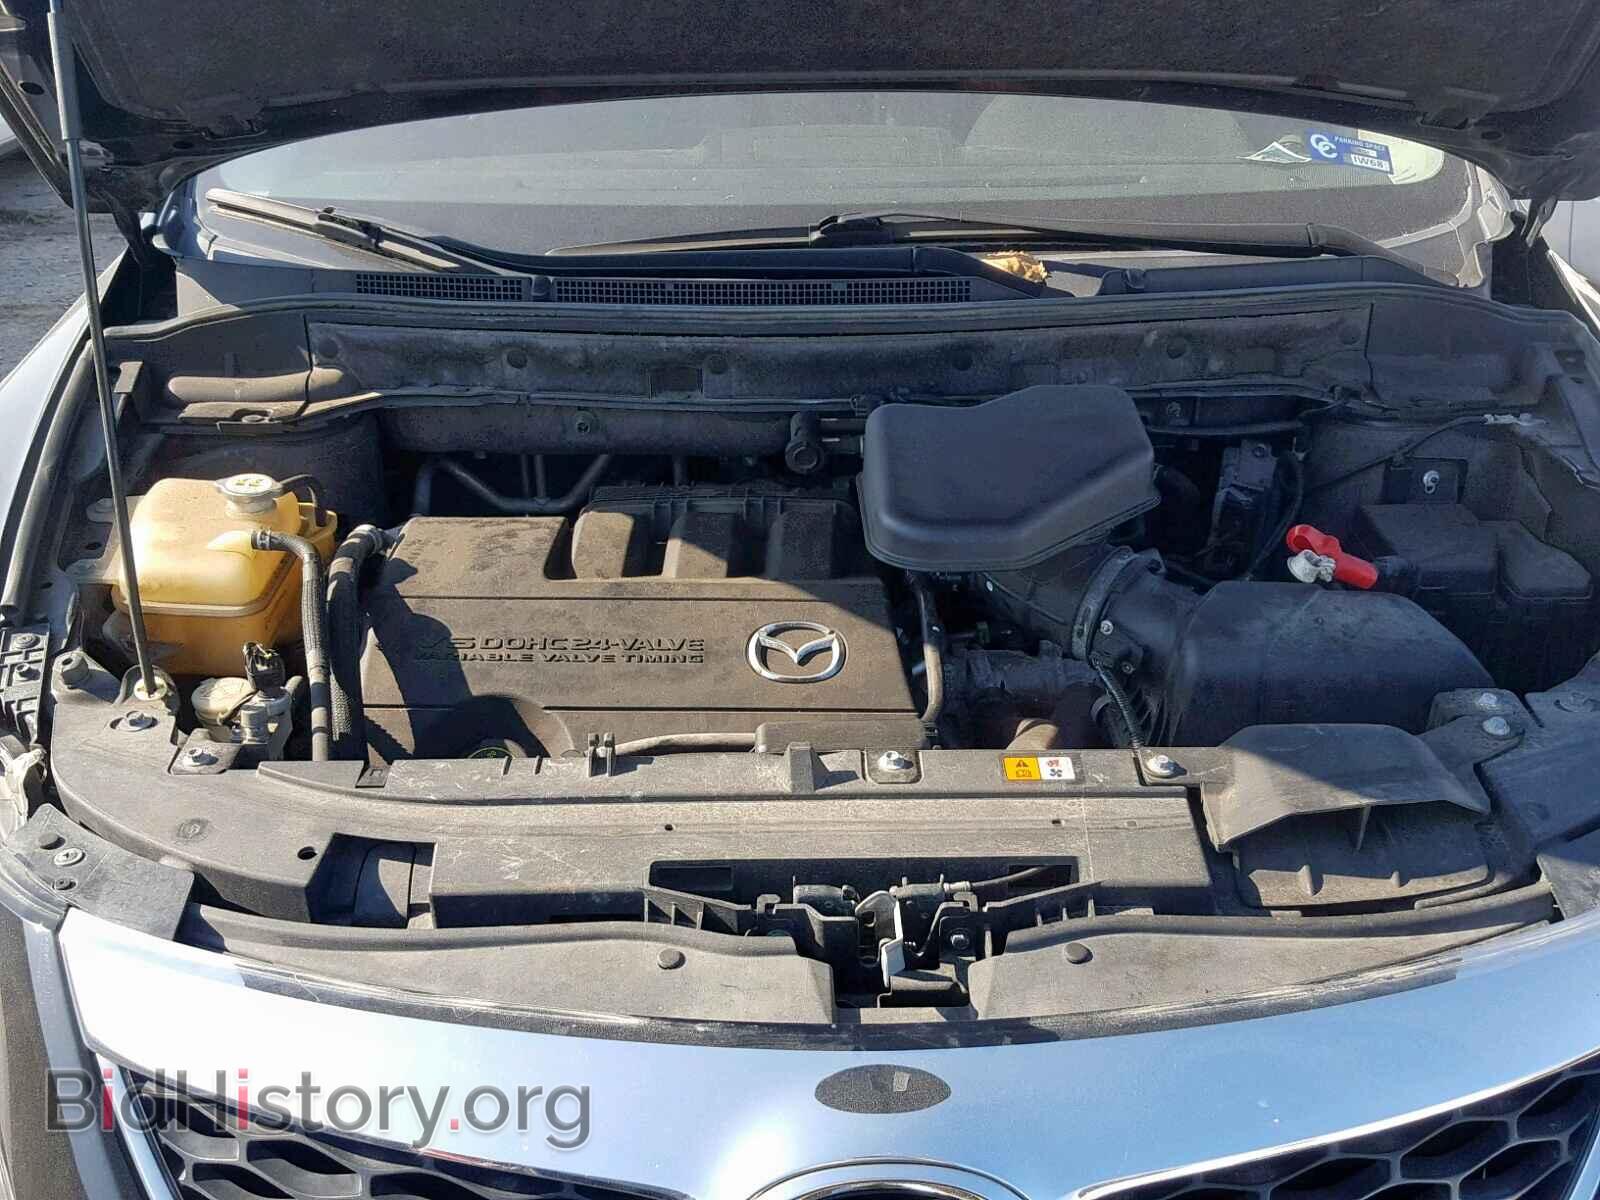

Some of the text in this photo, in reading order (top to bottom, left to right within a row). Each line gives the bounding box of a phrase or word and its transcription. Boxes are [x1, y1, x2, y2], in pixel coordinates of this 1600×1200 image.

[1334, 136, 1386, 151] PARKING SPACE
[480, 637, 569, 650] DOHC
[572, 637, 705, 651] 24-VALVE
[543, 653, 617, 663] VALVE
[623, 654, 705, 663] TIMING
